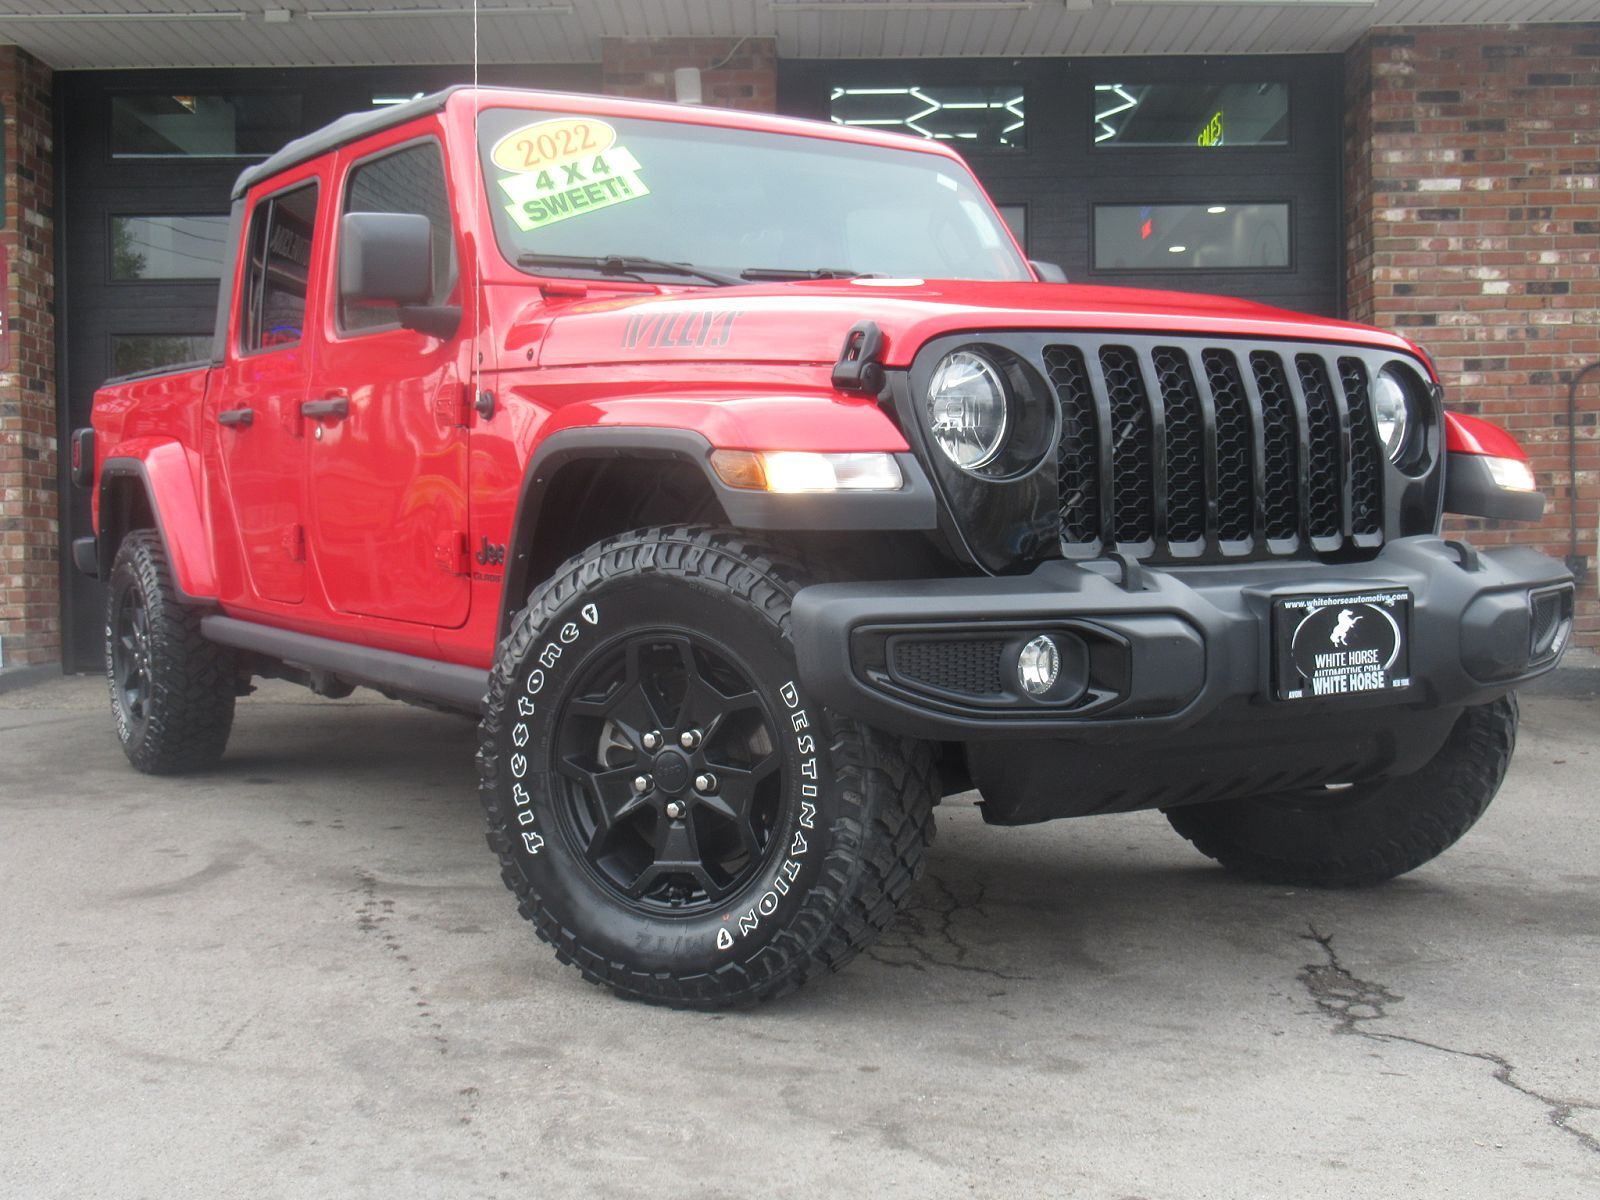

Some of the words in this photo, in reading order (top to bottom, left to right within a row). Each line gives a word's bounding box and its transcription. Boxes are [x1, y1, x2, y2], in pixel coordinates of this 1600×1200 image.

[516, 124, 597, 168] 2022
[535, 169, 555, 191] 4
[591, 154, 610, 175] 4
[522, 175, 630, 222] SWEET!
[476, 535, 506, 566] Jee
[1284, 592, 1408, 609] www.whitehorseautomotive.com
[1314, 652, 1347, 669] WHITE
[1348, 648, 1379, 666] HORSE
[1288, 690, 1303, 699] AVON
[1312, 674, 1348, 696] WHITE
[1349, 670, 1385, 692] HORSE
[511, 622, 580, 854] Firestone
[738, 681, 818, 936] DESTINATION
